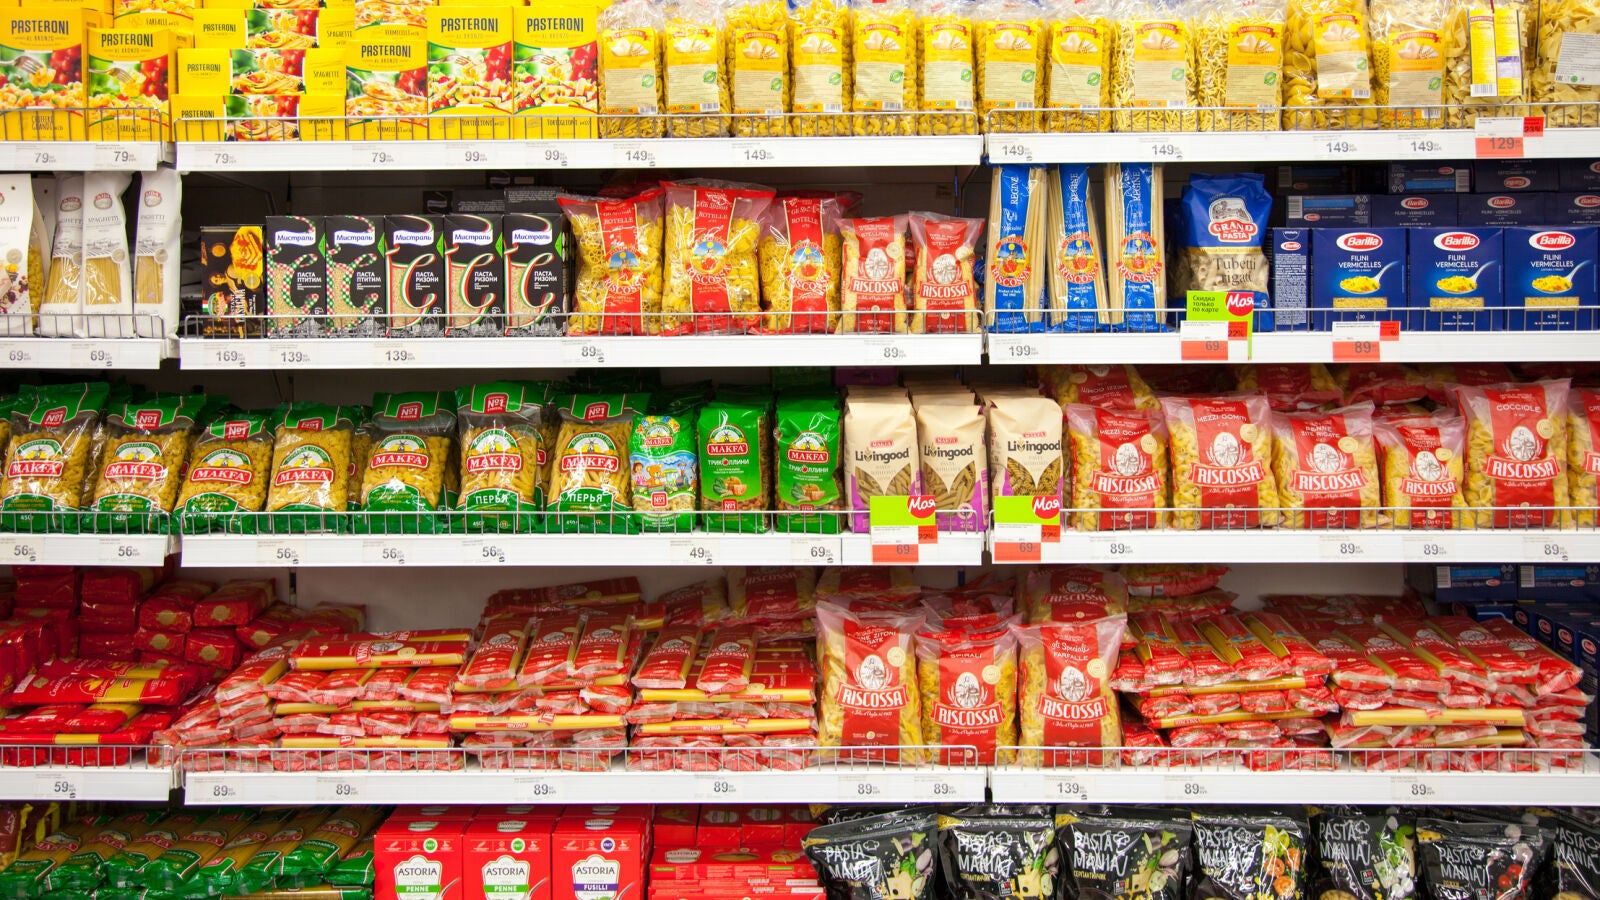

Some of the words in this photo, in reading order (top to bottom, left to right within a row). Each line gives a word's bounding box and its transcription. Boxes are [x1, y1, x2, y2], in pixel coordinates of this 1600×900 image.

[11, 19, 69, 35] PASTERONI
[203, 23, 236, 32] PASTERONI
[441, 18, 498, 33] PASTERONI
[526, 18, 584, 32] PASTERONI
[101, 33, 153, 47] PASTERONI
[362, 45, 411, 58] PASTERONI
[187, 63, 221, 72] PASTERONI
[181, 110, 215, 118] PASTERONI
[1326, 142, 1348, 153] 149
[1411, 141, 1433, 152] 149
[1489, 137, 1514, 149] 129
[744, 150, 766, 160] 149
[1002, 145, 1024, 156] 149
[1152, 144, 1174, 155] 149
[34, 152, 49, 163] 79
[114, 151, 128, 162] 79
[214, 153, 229, 164] 79
[372, 152, 386, 163] 79
[465, 151, 479, 162] 99
[545, 150, 559, 161] 99
[626, 150, 647, 161] 149
[604, 216, 633, 224] ROTELLE
[1212, 220, 1254, 233] GRAND
[277, 234, 313, 243] Мистраль
[336, 234, 372, 243] Мистраль
[395, 234, 432, 243] Мистраль
[454, 233, 491, 242] Мистраль
[514, 234, 550, 242] Мистраль
[1222, 232, 1246, 240] PASTA
[1346, 236, 1379, 247] Barilla
[1444, 236, 1476, 246] Barilla
[1539, 235, 1572, 246] Barilla
[1214, 257, 1256, 271] Tubetti
[1338, 261, 1381, 269] VERMICELLES
[686, 264, 732, 284] RISCOSSA
[991, 266, 1031, 287] RISCOSSA
[1060, 263, 1099, 284] RISCOSSA
[1117, 262, 1162, 283] RISCOSSA
[853, 281, 899, 292] RISCOSSA
[923, 285, 969, 297] RISCOSSA
[1227, 293, 1255, 310] Моя
[581, 346, 596, 357] 89
[1009, 346, 1031, 357] 199
[1205, 341, 1219, 351] 69
[1354, 342, 1371, 354] 89
[9, 351, 23, 361] 69
[90, 350, 105, 361] 69
[216, 351, 238, 361] 169
[281, 351, 303, 362] 139
[385, 351, 408, 361] 139
[883, 348, 898, 358] 89
[1496, 404, 1541, 413] COCCIOLE
[709, 444, 745, 454] MAKFA
[924, 444, 973, 461] Livingood
[1008, 438, 1061, 456] Livingood
[376, 455, 424, 465] MAKFA
[469, 456, 518, 468] MAKFA
[792, 452, 826, 463] MAKFA
[855, 449, 910, 465] Livingood
[12, 463, 61, 474] MAKFA
[565, 458, 615, 469] MAKFA
[1492, 461, 1556, 476] RISCOSSA
[110, 465, 159, 477] MAKFA
[195, 470, 246, 481] MAKFA
[280, 471, 328, 482] MAKFA
[1198, 467, 1260, 483] RISCOSSA
[1098, 476, 1156, 493] RISCOSSA
[1299, 474, 1360, 492] RISCOSSA
[1406, 481, 1456, 494] RISCOSSA
[475, 494, 509, 504] ПЕРЬЯ
[569, 493, 603, 502] ПЕРЬЯ
[909, 499, 935, 512] Моя
[1033, 499, 1060, 512] Моя
[14, 545, 28, 556] 56
[118, 546, 132, 556] 56
[277, 548, 291, 559] 56
[382, 548, 397, 559] 56
[482, 546, 497, 557] 56
[690, 548, 704, 558] 49
[810, 546, 826, 558] 69
[896, 545, 910, 555] 69
[1019, 543, 1033, 553] 69
[1110, 543, 1125, 554] 89
[1340, 543, 1355, 554] 89
[1424, 544, 1438, 555] 89
[1544, 544, 1559, 555] 89
[1053, 652, 1088, 662] FARFALLE
[842, 691, 902, 707] RISCOSSA
[1042, 699, 1104, 720] RISCOSSA
[939, 709, 998, 726] RISCOSSA
[54, 782, 68, 793] 59
[213, 786, 228, 796] 89
[336, 785, 350, 795] 89
[534, 784, 548, 795] 89
[714, 782, 728, 793] 89
[857, 784, 872, 794] 89
[934, 784, 948, 794] 89
[1056, 782, 1080, 794] 139
[1184, 784, 1199, 794] 89
[1411, 784, 1426, 795] 89
[1320, 822, 1356, 840] PASTA
[1074, 832, 1113, 850] PASTA
[1199, 828, 1234, 848] PASTA
[825, 843, 864, 862] PASTA
[1321, 842, 1371, 862] MANIA
[1439, 847, 1471, 864] PASTA
[1074, 852, 1128, 872] MANIA
[398, 868, 437, 876] ASTORIA
[486, 868, 525, 876] ASTORIA
[576, 867, 615, 875] ASTORIA
[1441, 864, 1486, 882] MANIA
